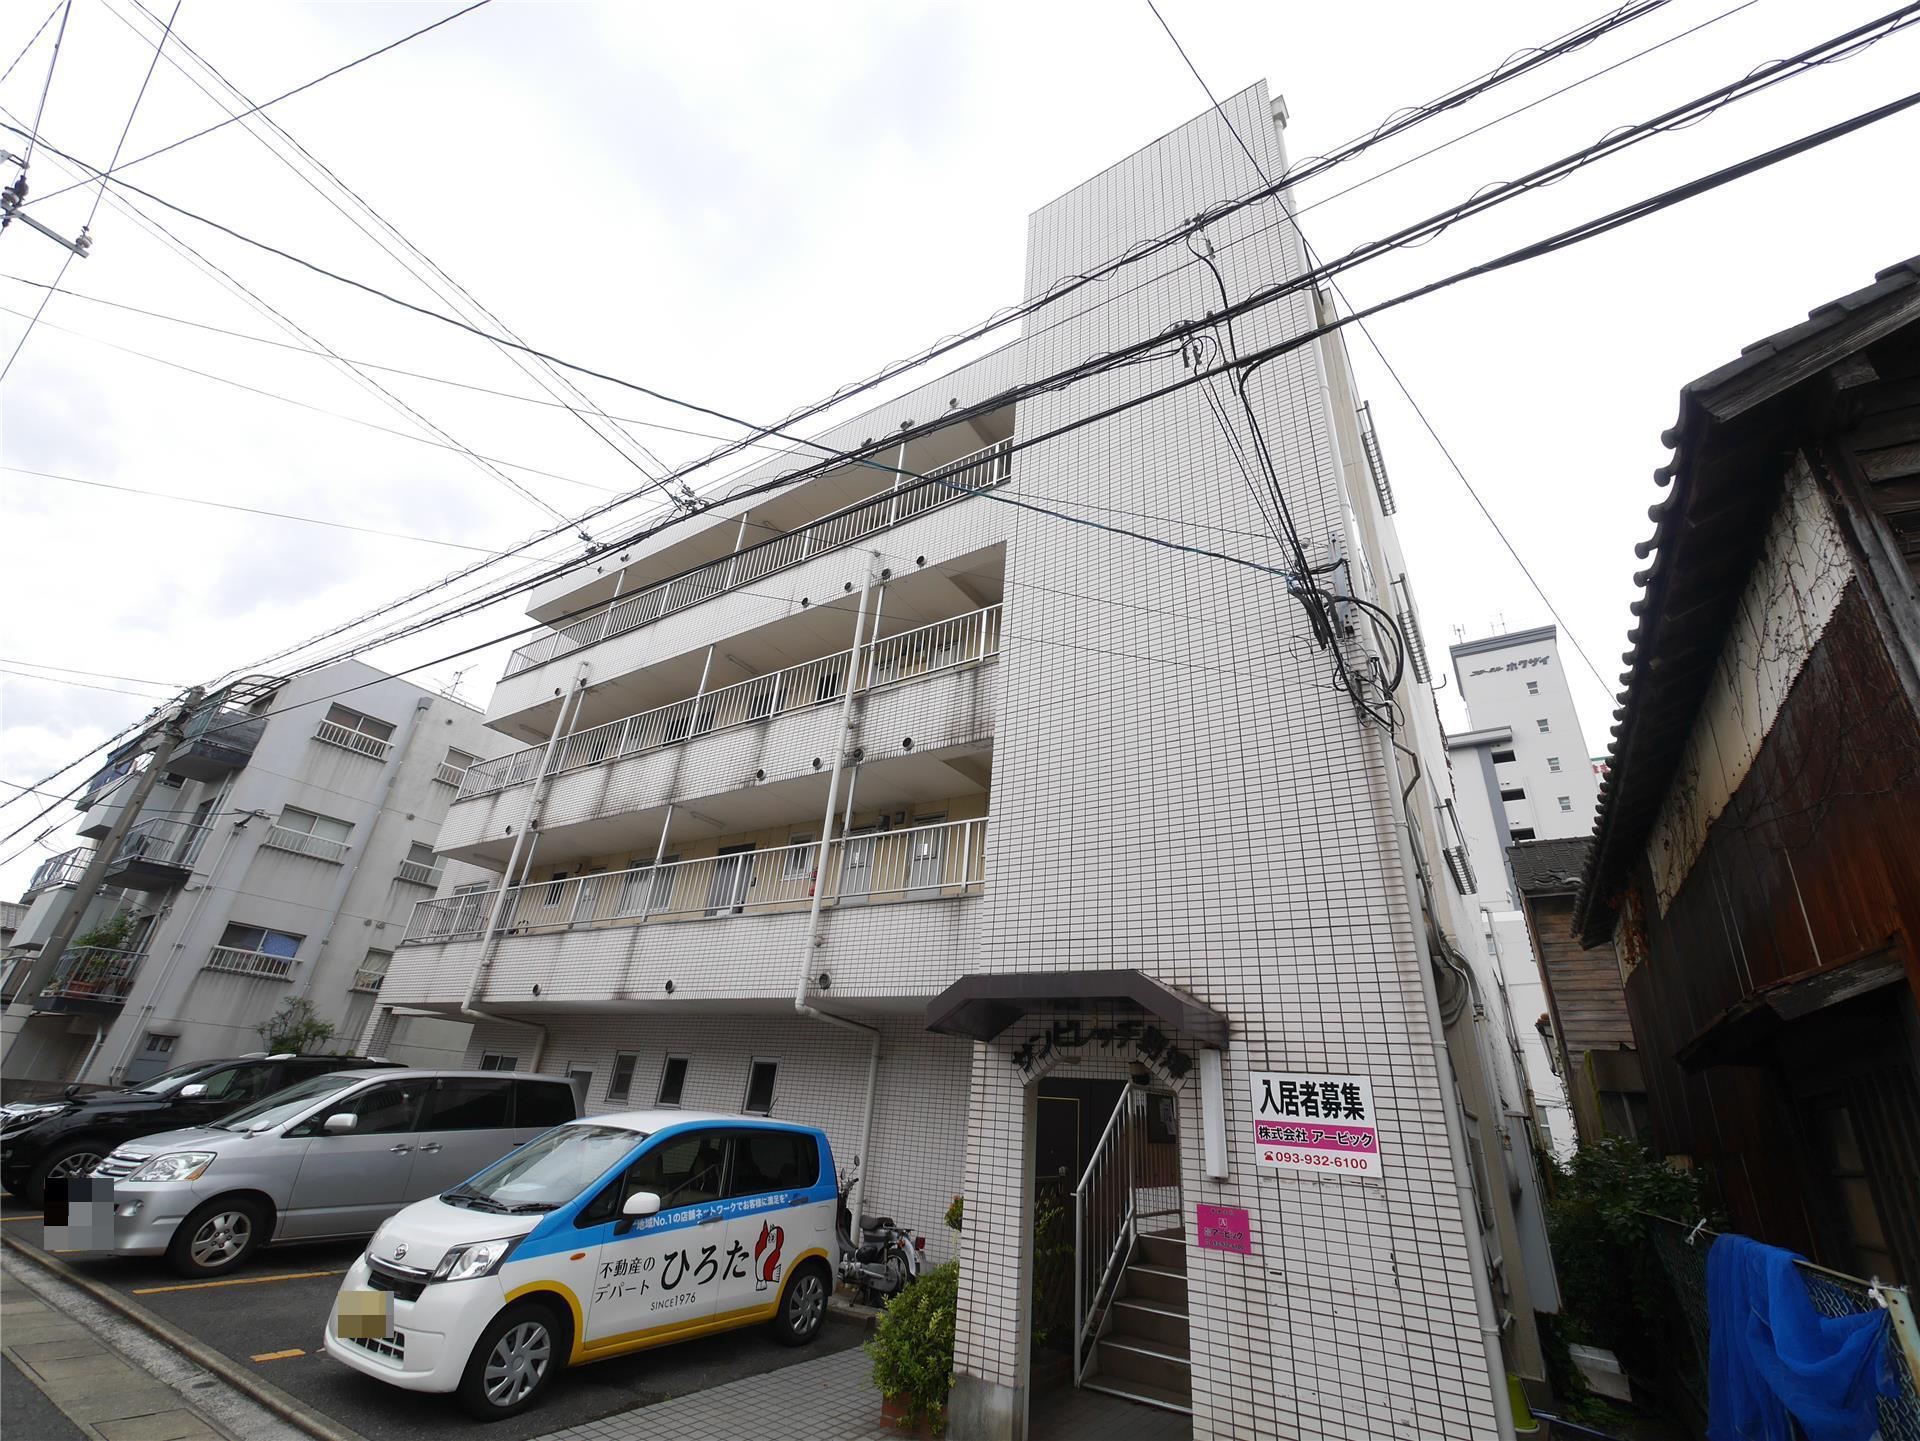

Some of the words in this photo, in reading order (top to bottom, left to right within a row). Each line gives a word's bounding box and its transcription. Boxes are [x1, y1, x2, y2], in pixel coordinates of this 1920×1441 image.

[1260, 1079, 1365, 1121] 入居者募集
[1258, 1125, 1309, 1142] 株式会社
[1311, 1130, 1373, 1148] アービック
[1275, 1151, 1368, 1170] 093-932-6100
[600, 1256, 656, 1279] 不動産の
[660, 1239, 750, 1291] ひろた
[595, 1279, 650, 1303] デパート
